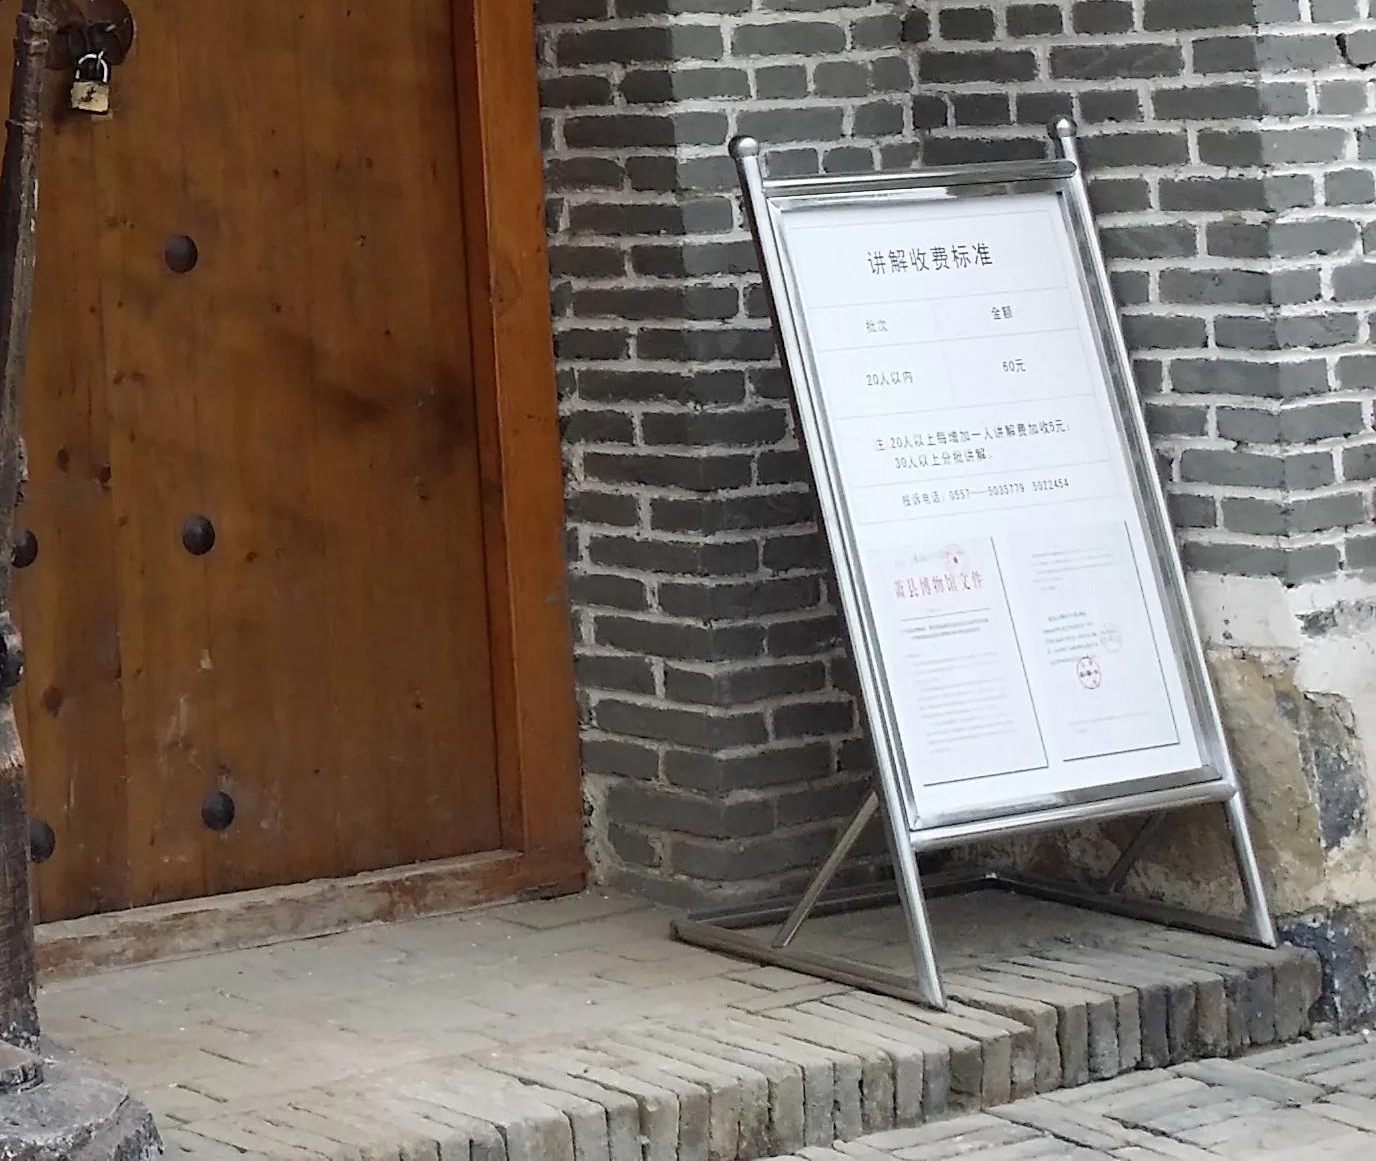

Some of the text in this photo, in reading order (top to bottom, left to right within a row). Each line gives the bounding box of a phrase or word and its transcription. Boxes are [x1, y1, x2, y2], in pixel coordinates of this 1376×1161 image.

[866, 242, 993, 275] 讲解收费标准
